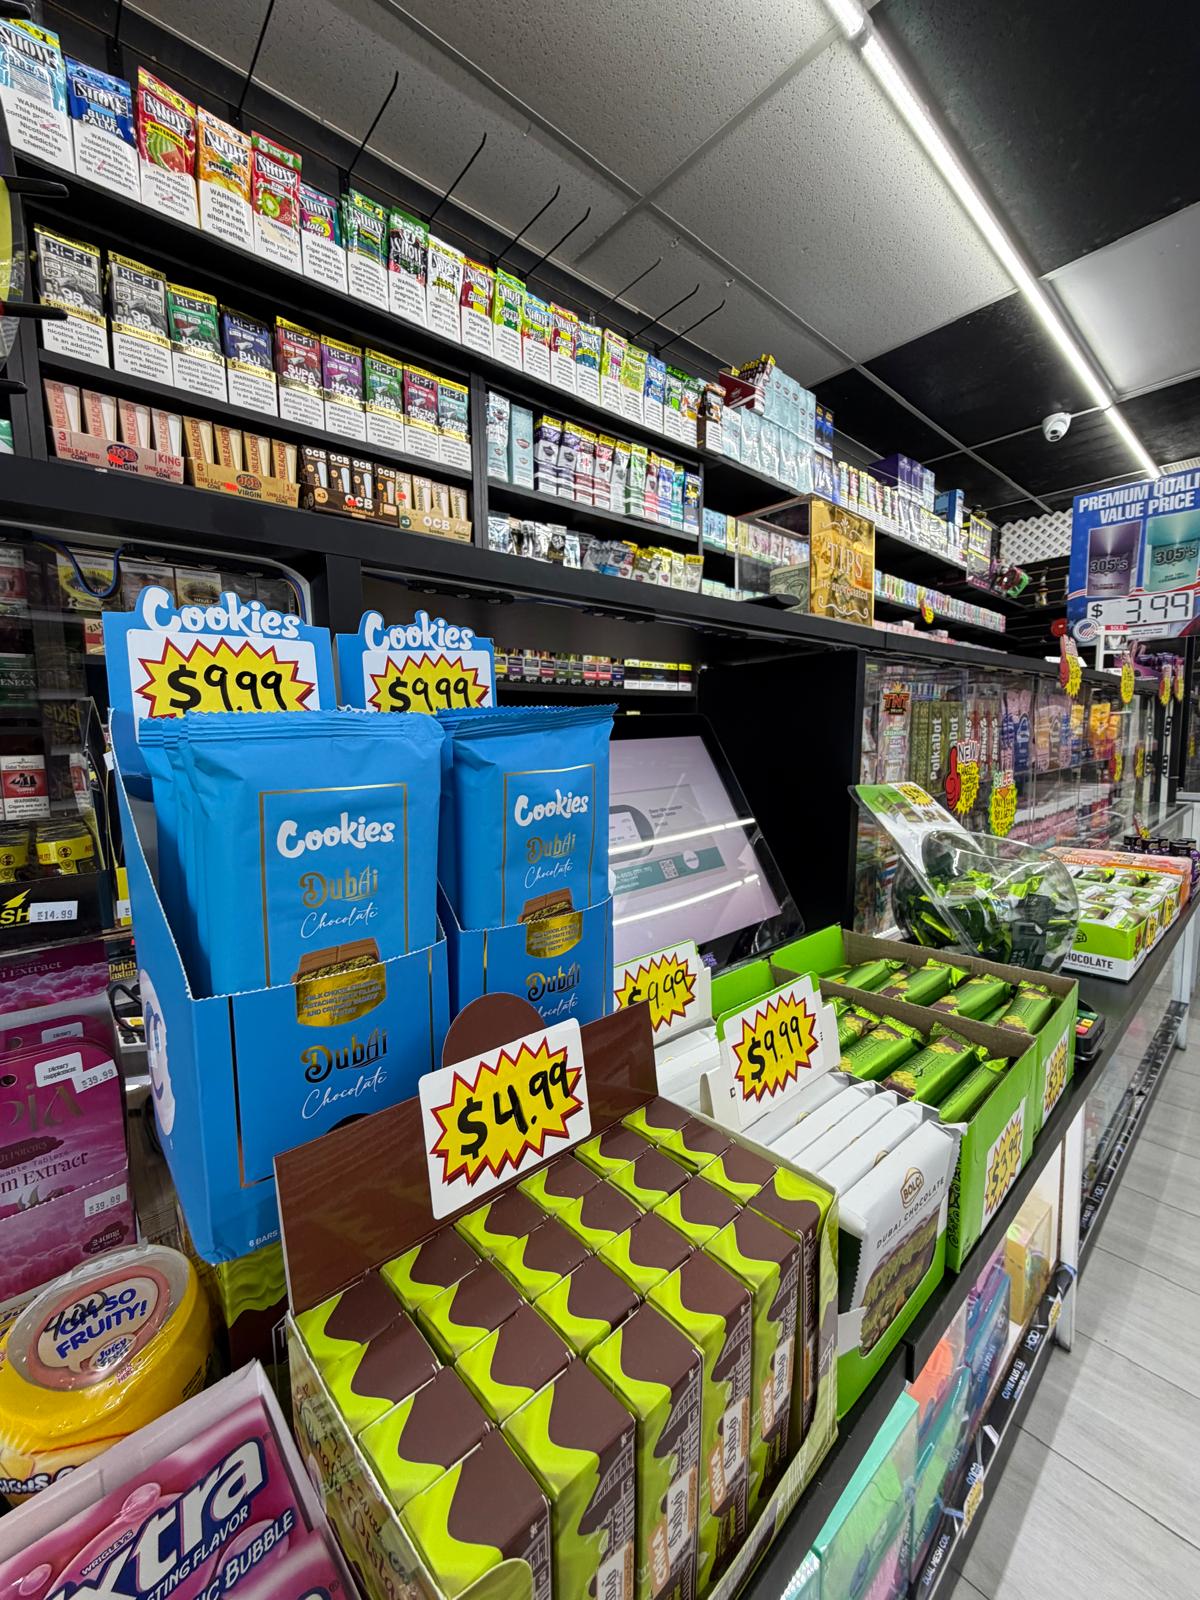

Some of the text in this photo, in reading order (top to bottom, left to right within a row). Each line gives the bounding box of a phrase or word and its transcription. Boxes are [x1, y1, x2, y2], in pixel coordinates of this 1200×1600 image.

[82, 114, 124, 138] PALMA
[87, 109, 118, 128] BLUE
[48, 240, 89, 266] HI-FI
[119, 267, 158, 290] HI-FI
[62, 287, 85, 303] 98
[175, 295, 209, 313] HI-FI
[115, 314, 167, 338] DIAMOND
[129, 309, 151, 325] 98
[231, 316, 262, 334] HI-FI
[285, 330, 314, 348] HI-FI
[329, 349, 356, 365] HI-FI
[371, 361, 397, 377] HI-FI
[330, 380, 359, 395] HAZY
[53, 383, 67, 429] NBLEACHED
[91, 393, 103, 437] NBLEACHED
[58, 430, 67, 442] 3
[126, 403, 137, 446] NBLEACHED
[158, 411, 169, 453] NBLEACHED
[57, 445, 101, 460] UNBLEACHED
[191, 419, 204, 460] NBLEACHED
[220, 427, 232, 468] NBLEACHED
[158, 453, 182, 468] KING
[250, 435, 260, 474] NBLEACHED
[277, 442, 287, 480] NBLEACHED
[305, 447, 327, 460] OCB
[329, 453, 350, 466] OCB
[352, 459, 373, 471] OCB
[377, 466, 397, 480] OCB
[414, 477, 432, 489] OCB
[237, 488, 262, 500] VIRGIN
[344, 494, 374, 511] OCB
[1078, 483, 1150, 515] PREMIUM
[1099, 490, 1196, 525] VALUE PRICE
[422, 515, 452, 532] OCB
[828, 541, 864, 579] TIPS
[1089, 558, 1129, 577] 305's
[1154, 544, 1198, 566] 305's
[142, 586, 301, 640] Cookies
[364, 611, 474, 652] Cookies
[166, 664, 289, 714] $9.99
[387, 676, 473, 714] $9.99
[930, 718, 942, 781] PolkaDot
[513, 788, 590, 827] Cookies
[276, 811, 396, 859] Cookies
[524, 857, 575, 890] Chocolate
[300, 901, 379, 940] Chocolate
[108, 960, 137, 974] Dutch
[1066, 953, 1115, 970] HOCOLATE
[538, 993, 580, 1019] hocolate
[746, 1014, 804, 1084] $9.99
[301, 1065, 388, 1121] Chocolate
[456, 1060, 571, 1160] $4.99
[23, 1151, 90, 1187] Extract
[876, 1176, 945, 1249] DUBAI CHOCOLATE
[255, 1230, 278, 1246] BARS
[104, 1288, 137, 1313] SO
[55, 1299, 148, 1360] FRUITY!
[97, 1337, 127, 1362] Juicy
[193, 1504, 249, 1569] FLAVOR
[225, 1509, 294, 1589] BUBBLE
[81, 1529, 134, 1577] WRIGLEY'S
[651, 1526, 669, 1586] CHIKA
[922, 1548, 945, 1586] DUAL MESH
